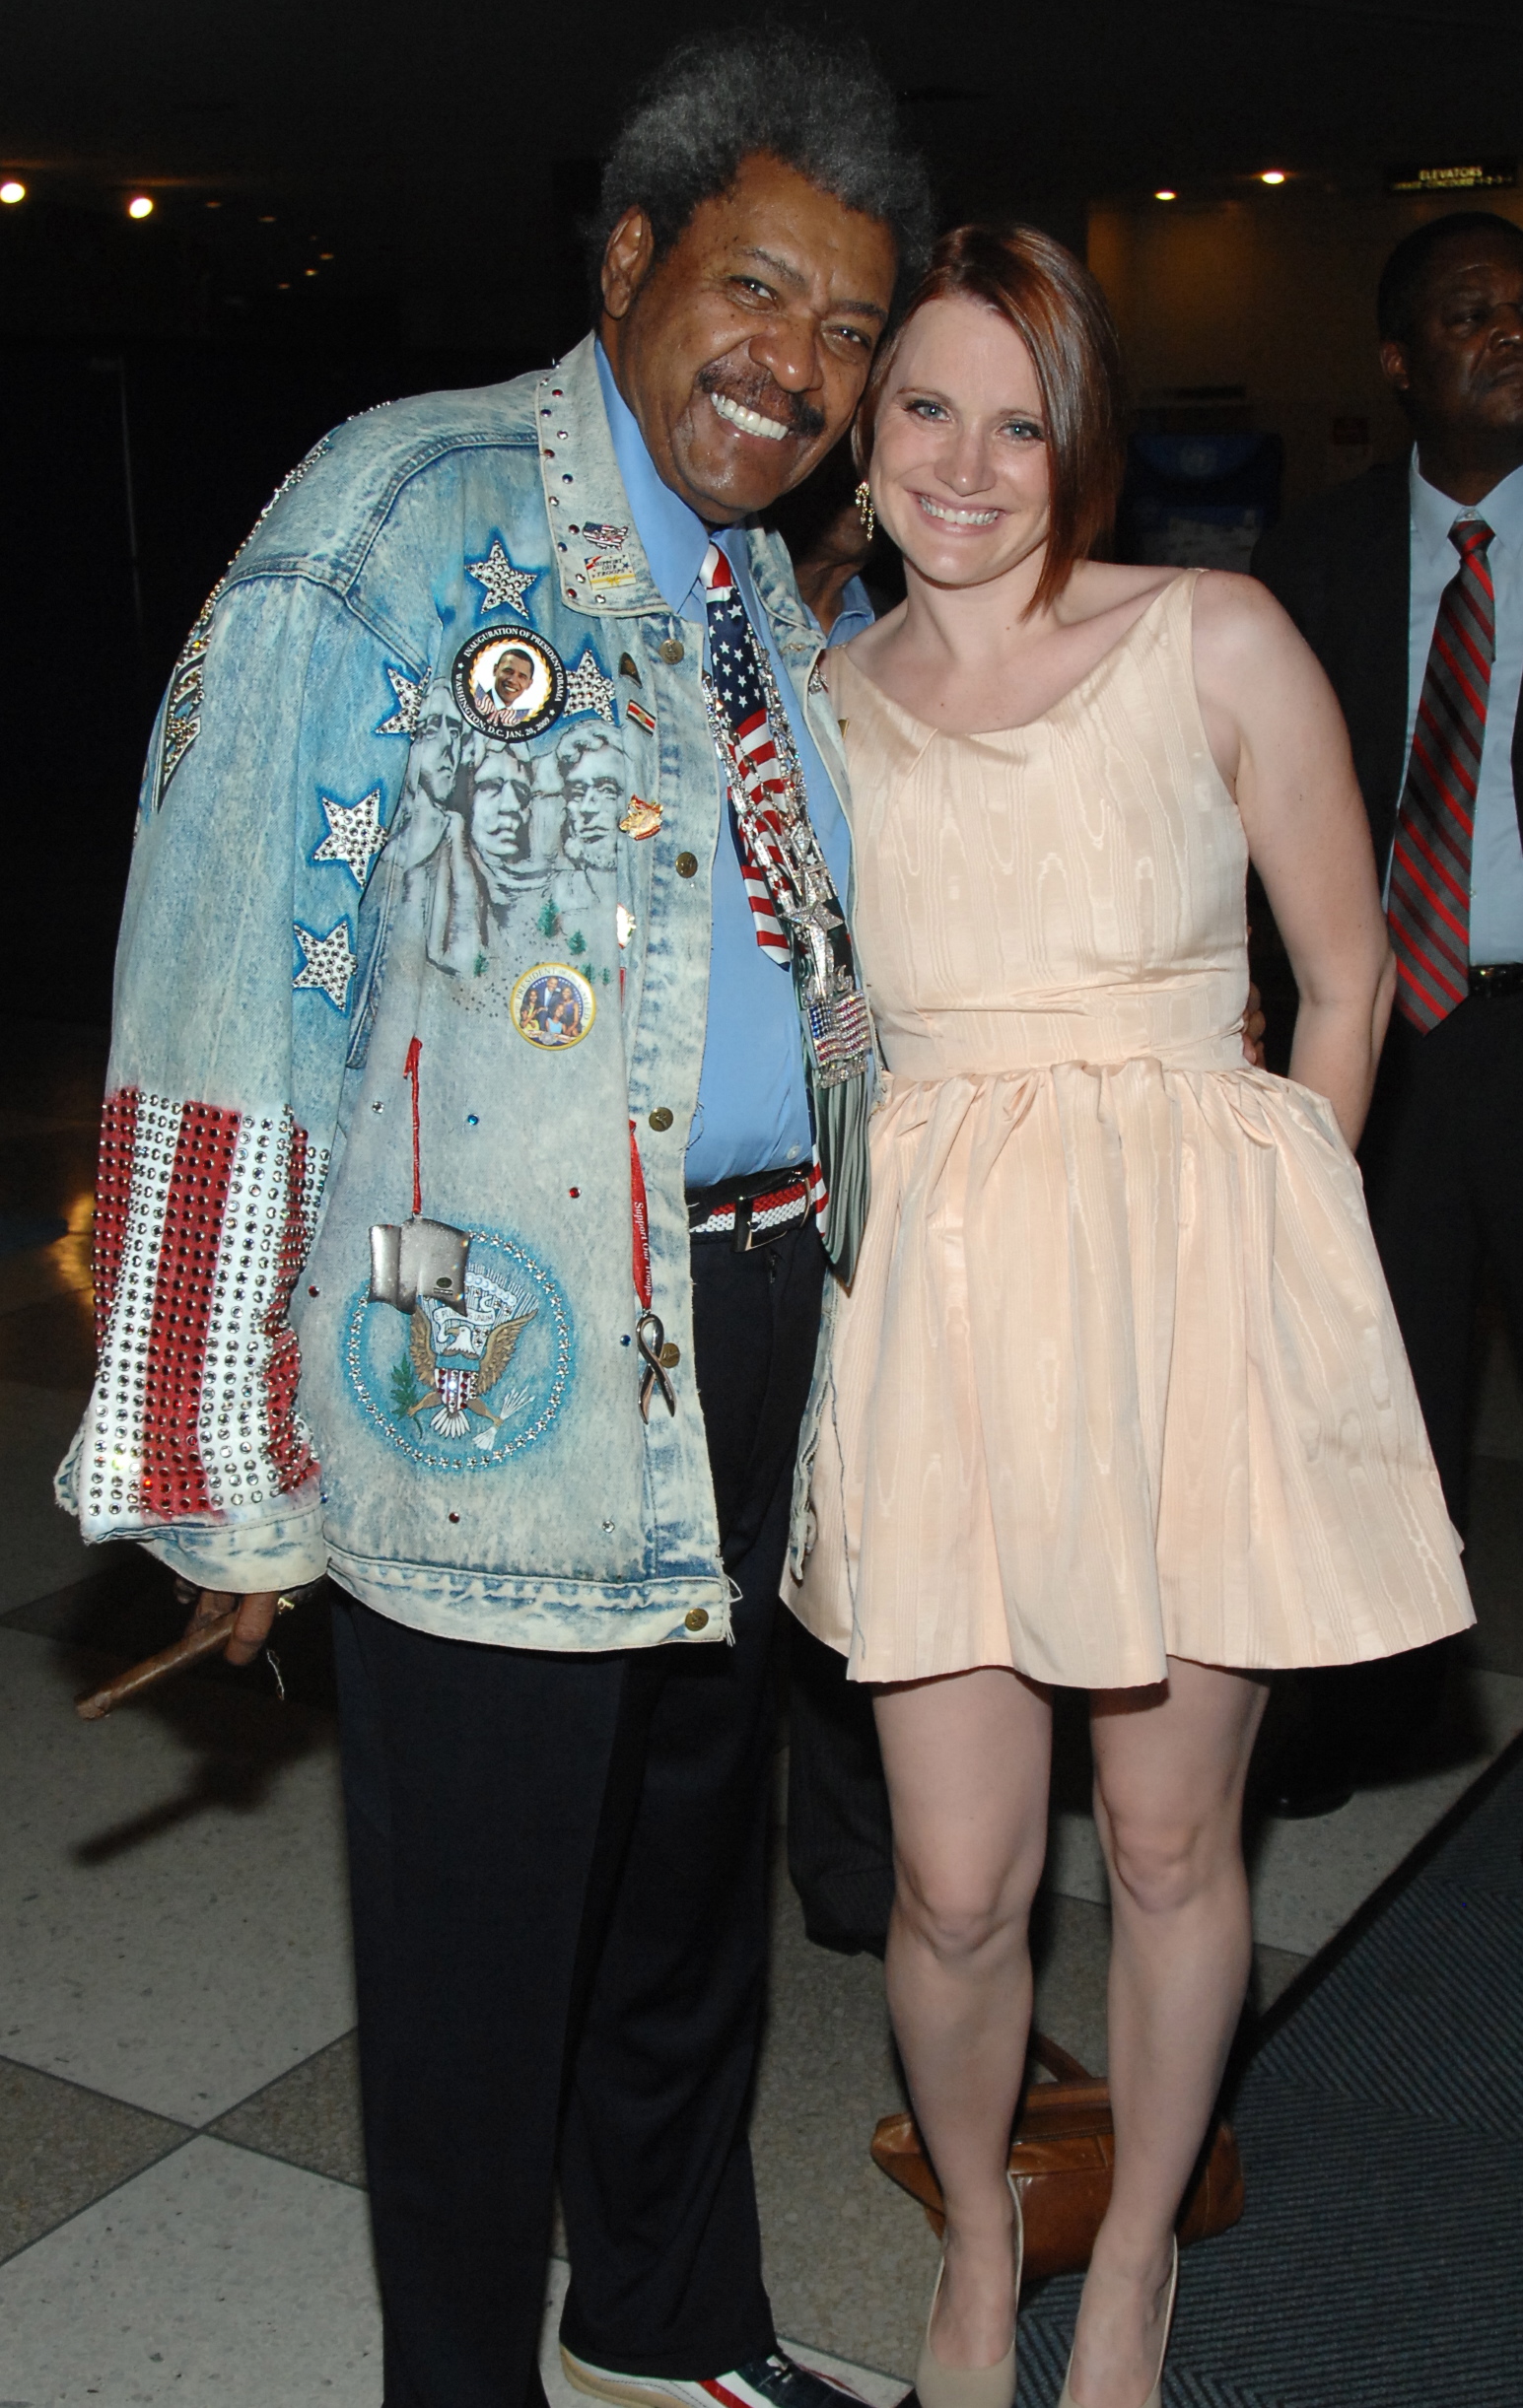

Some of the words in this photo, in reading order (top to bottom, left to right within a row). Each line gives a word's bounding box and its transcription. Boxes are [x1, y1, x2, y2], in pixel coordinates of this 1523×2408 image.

[1419, 167, 1483, 180] ELEVATORS
[463, 627, 519, 657] INAUGURATION
[519, 630, 530, 640] OF
[530, 631, 562, 671] PRESIDENT
[555, 671, 565, 702] OBAMA
[455, 673, 486, 731] WASHINGTON,
[487, 726, 505, 737] D.C.
[505, 729, 523, 739] JAN.
[516, 968, 557, 1000] PRESIDENT
[634, 1202, 648, 1240] Support
[642, 1242, 651, 1262] Our
[644, 1266, 653, 1296] Troops
